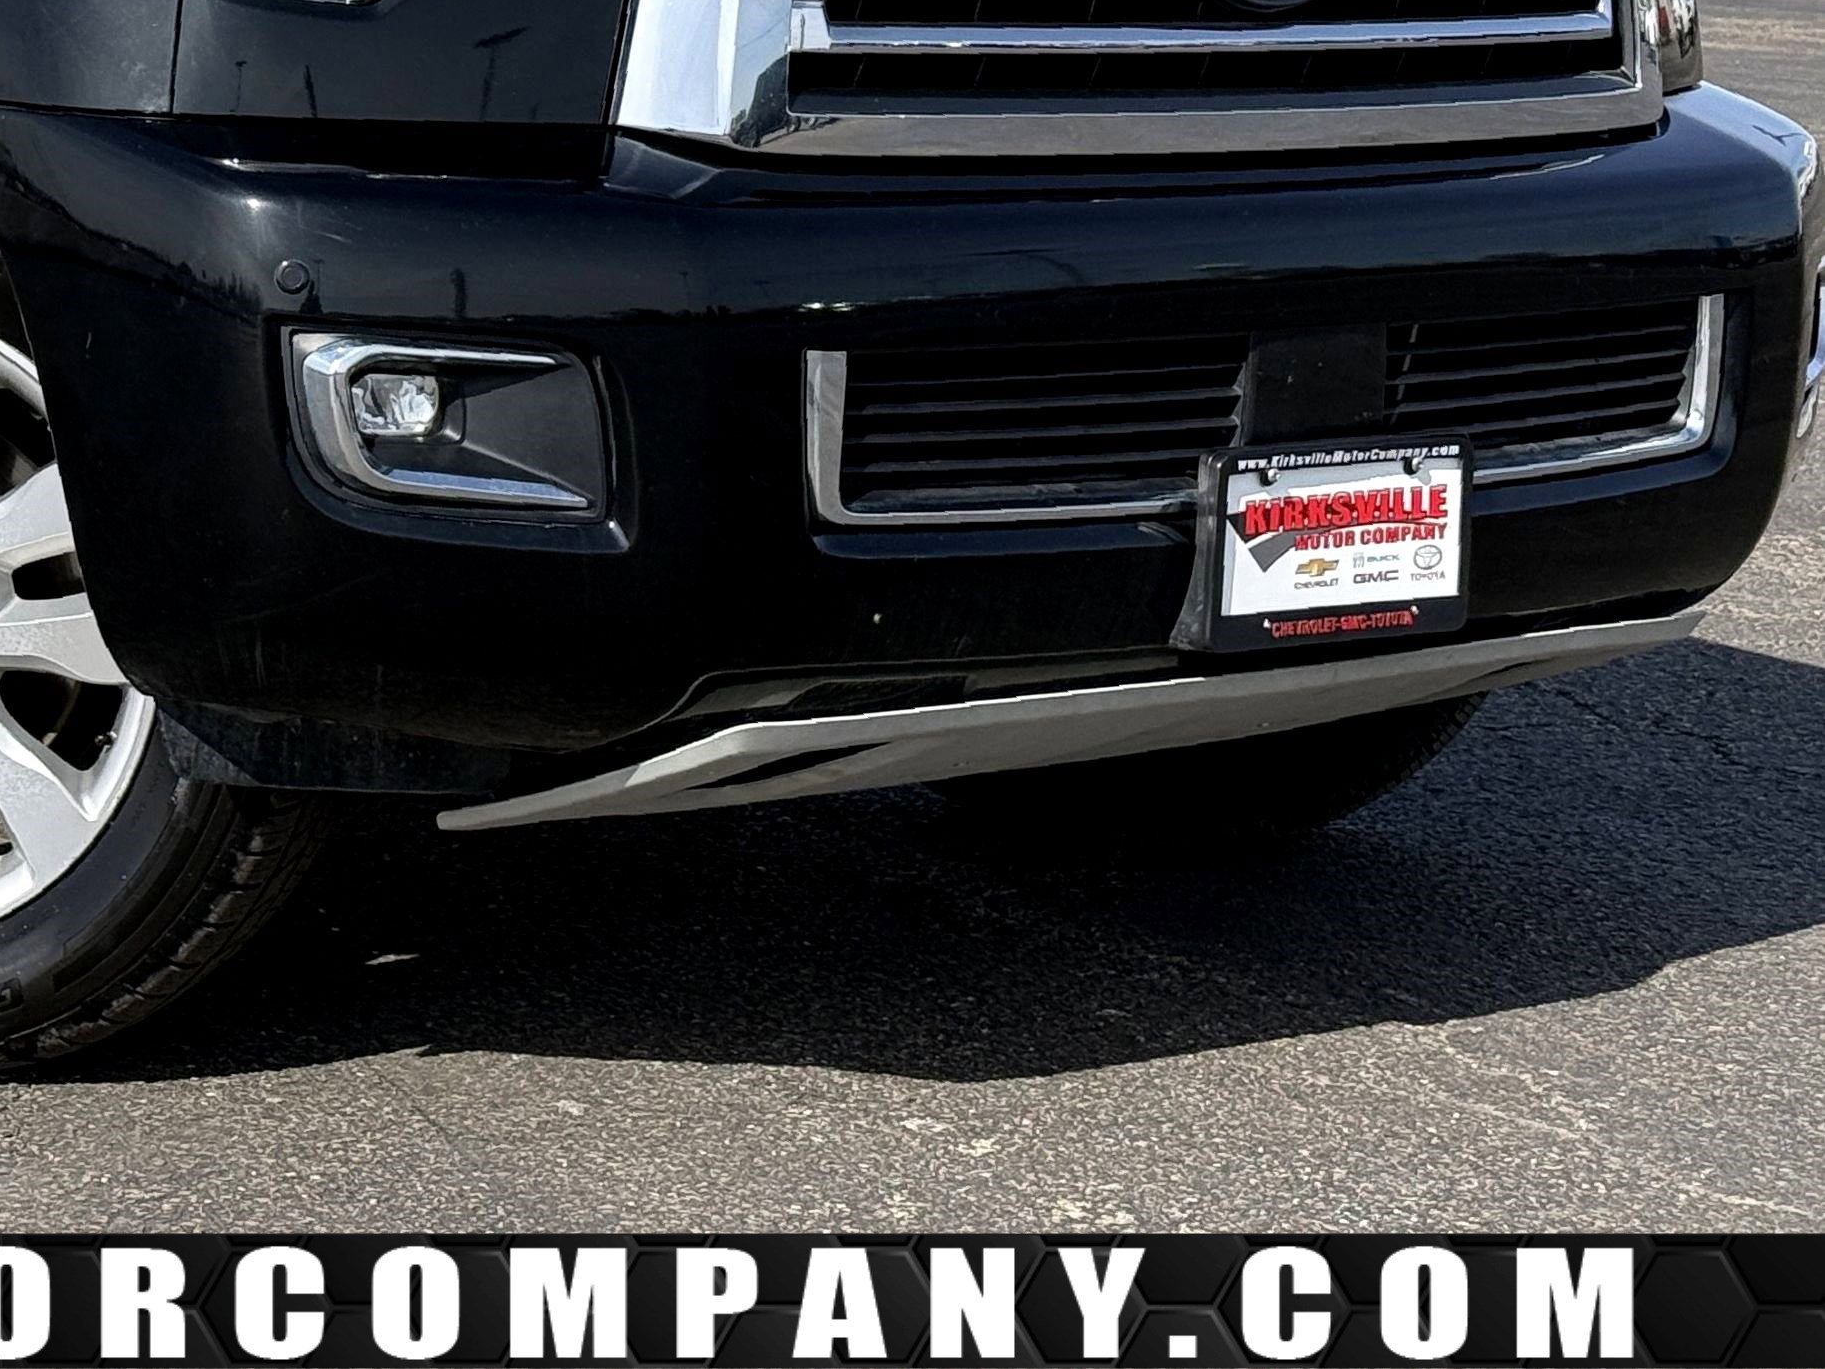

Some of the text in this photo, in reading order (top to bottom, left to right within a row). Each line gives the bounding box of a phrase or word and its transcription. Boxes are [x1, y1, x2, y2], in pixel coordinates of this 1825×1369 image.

[1244, 484, 1448, 536] KIRKSVILLE
[1294, 523, 1447, 552] MOTOR COMPANY
[1367, 554, 1400, 563] BUICK
[1353, 570, 1399, 584] GMC
[1410, 571, 1446, 581] TOYOTA
